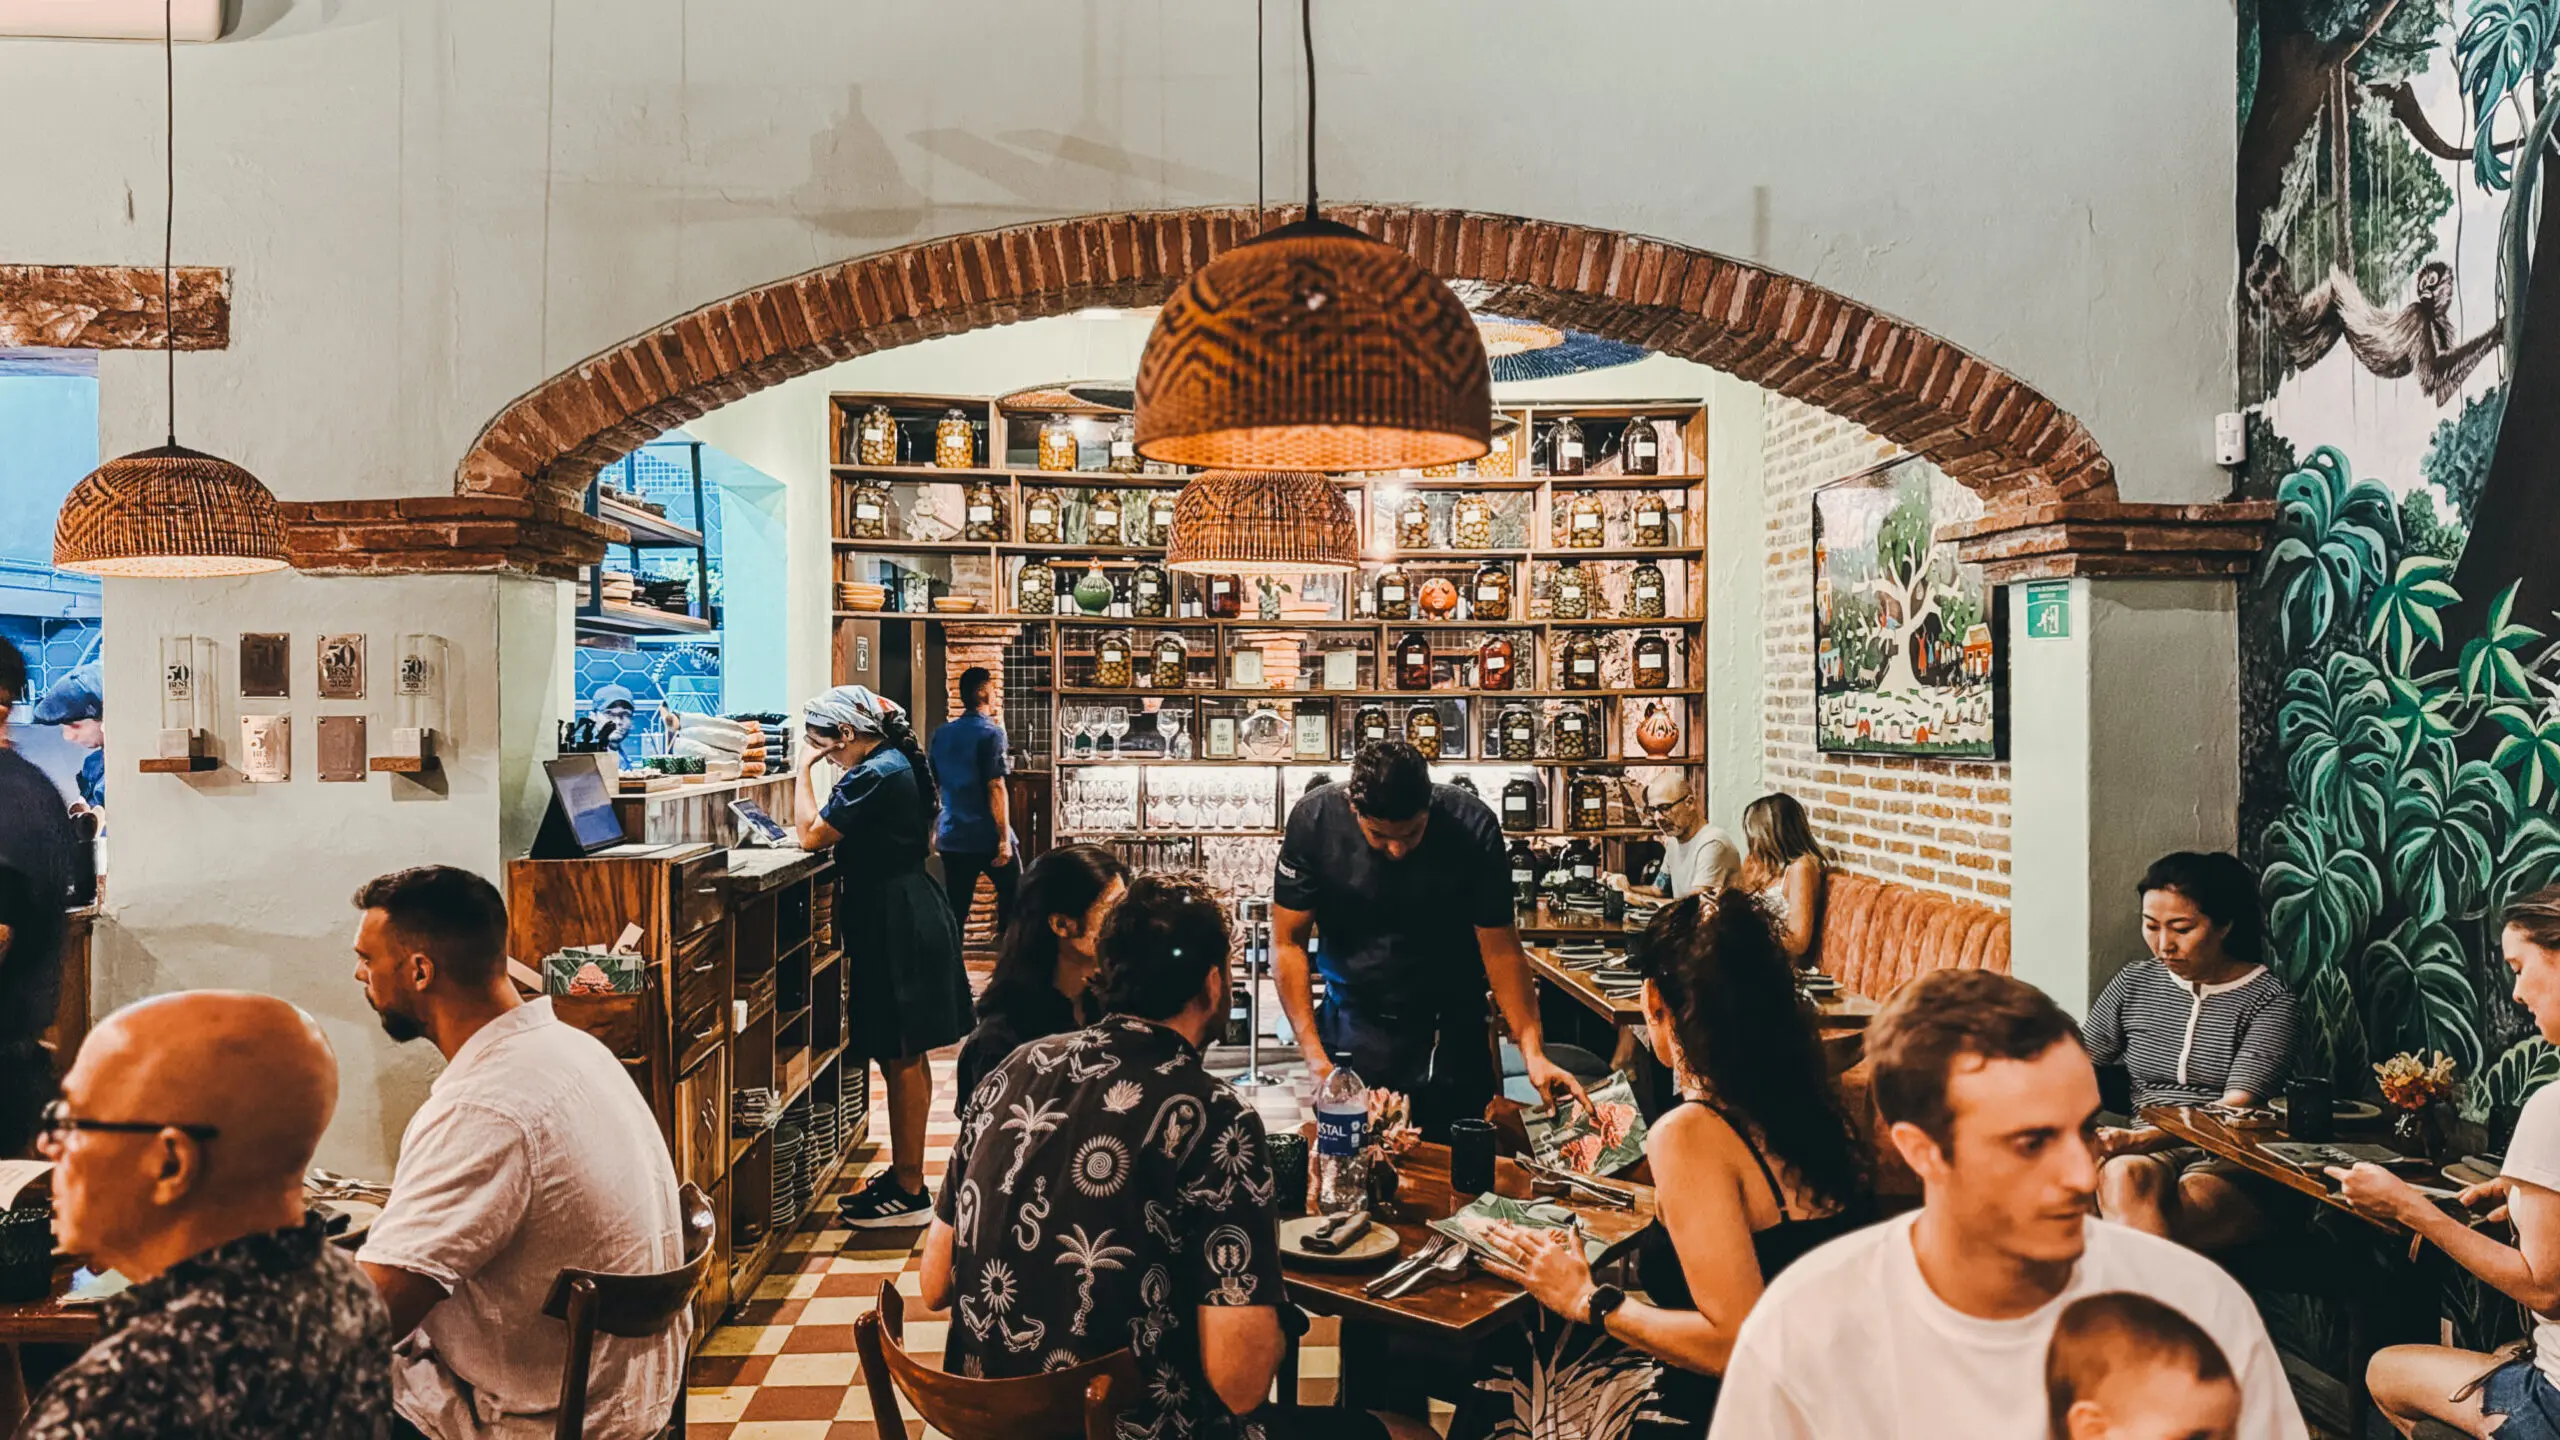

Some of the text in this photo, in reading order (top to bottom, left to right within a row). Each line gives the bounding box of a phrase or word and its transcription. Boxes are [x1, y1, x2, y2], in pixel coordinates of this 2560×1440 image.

[325, 644, 356, 668] 50
[167, 664, 190, 682] 50
[400, 659, 423, 676] 50
